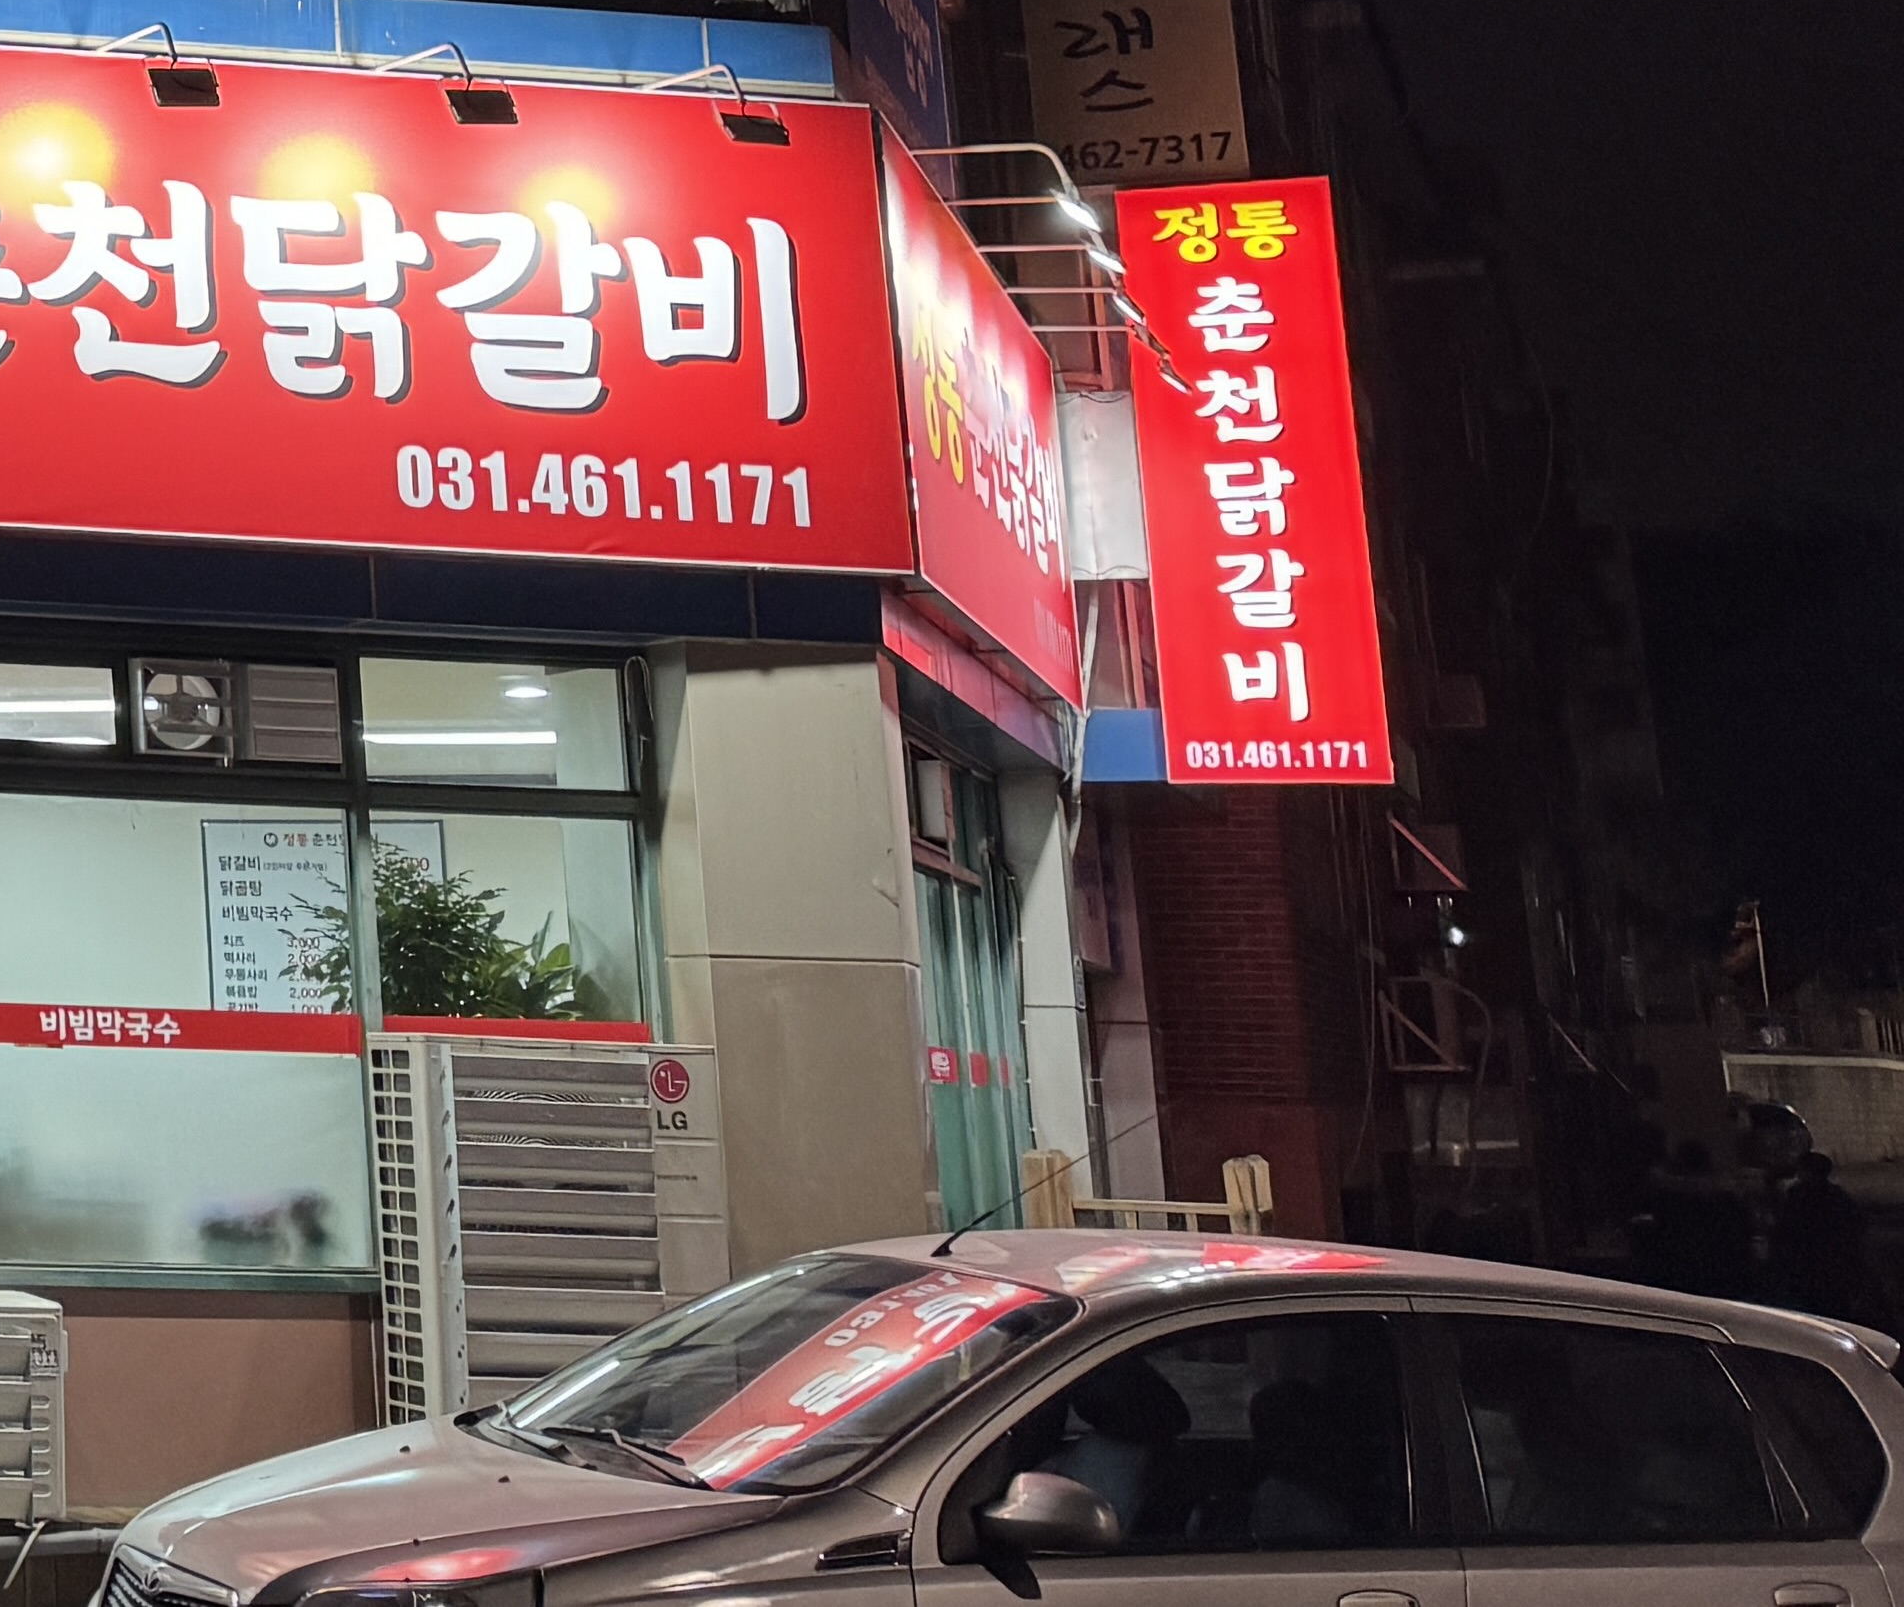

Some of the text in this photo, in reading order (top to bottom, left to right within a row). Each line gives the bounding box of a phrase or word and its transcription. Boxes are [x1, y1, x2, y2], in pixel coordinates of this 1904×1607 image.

[1060, 131, 1232, 171] 462-7317
[1152, 200, 1298, 263] 정통
[396, 445, 813, 530] 031.461.1171
[1187, 276, 1310, 724] 춘천닭갈비
[1185, 739, 1369, 770] 031.461.1171
[218, 855, 261, 872] 닭갈비
[222, 905, 294, 922] 비빔막국수
[39, 1009, 182, 1044] 비빔막국수
[656, 1110, 688, 1131] LG
